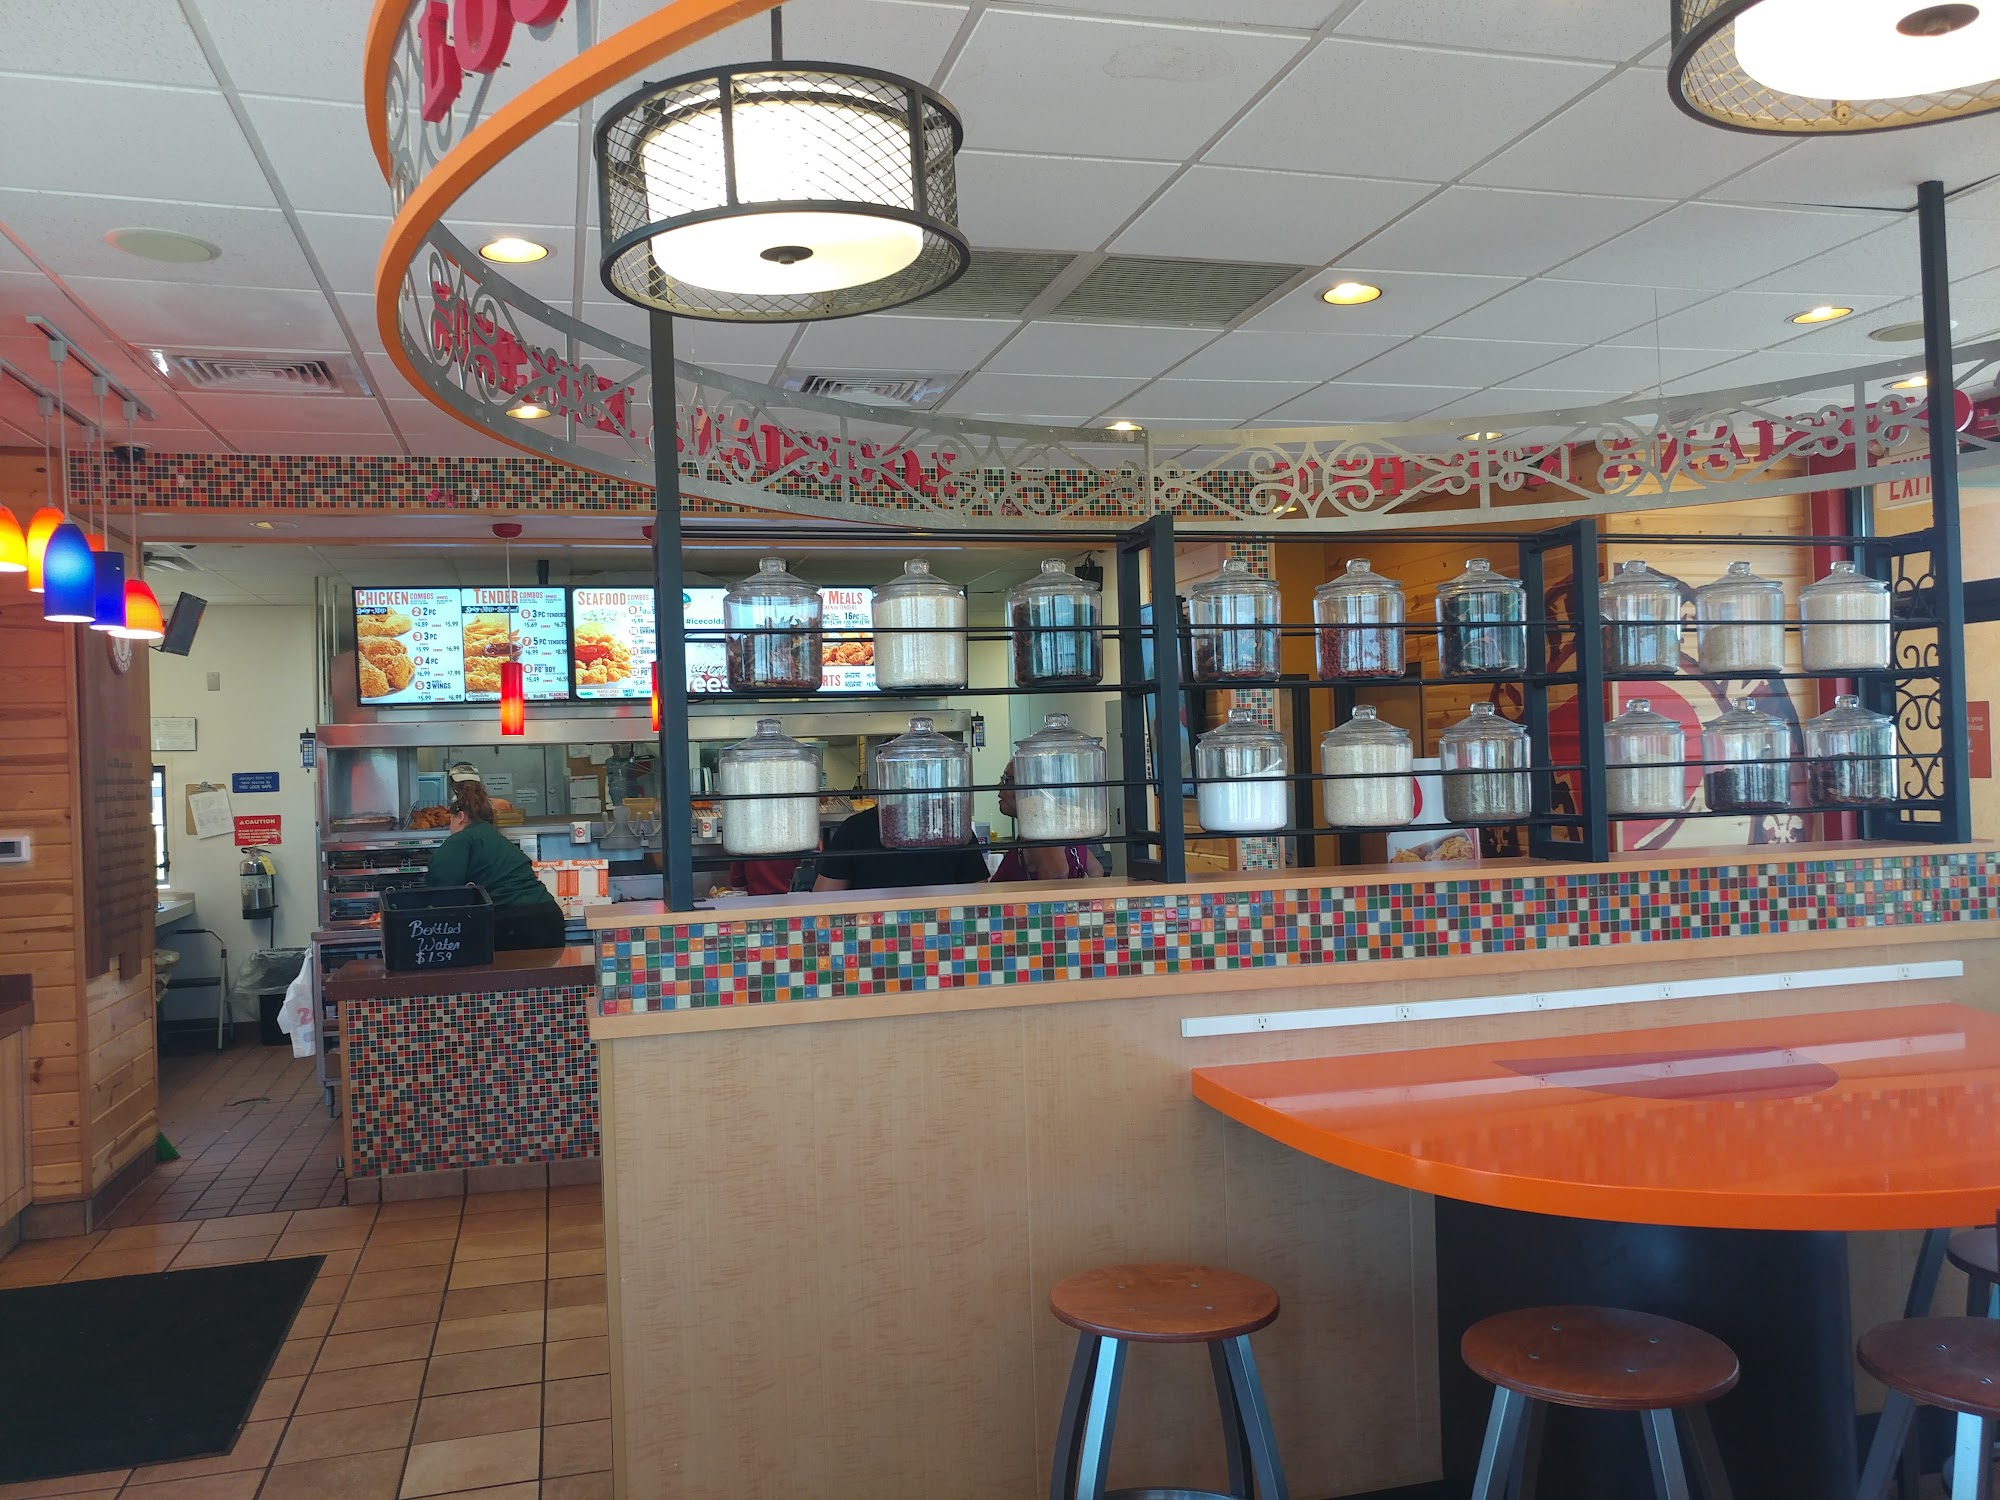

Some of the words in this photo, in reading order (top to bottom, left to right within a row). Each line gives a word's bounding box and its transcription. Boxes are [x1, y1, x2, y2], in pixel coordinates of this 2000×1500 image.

[356, 589, 409, 606] CHICKEN
[410, 592, 434, 600] COMBOS
[473, 588, 518, 604] TENDER
[578, 591, 626, 606] SEAFOOD
[829, 591, 863, 604] MEALS
[426, 682, 431, 690] 3
[408, 920, 461, 938] Bottled
[417, 937, 460, 951] Water
